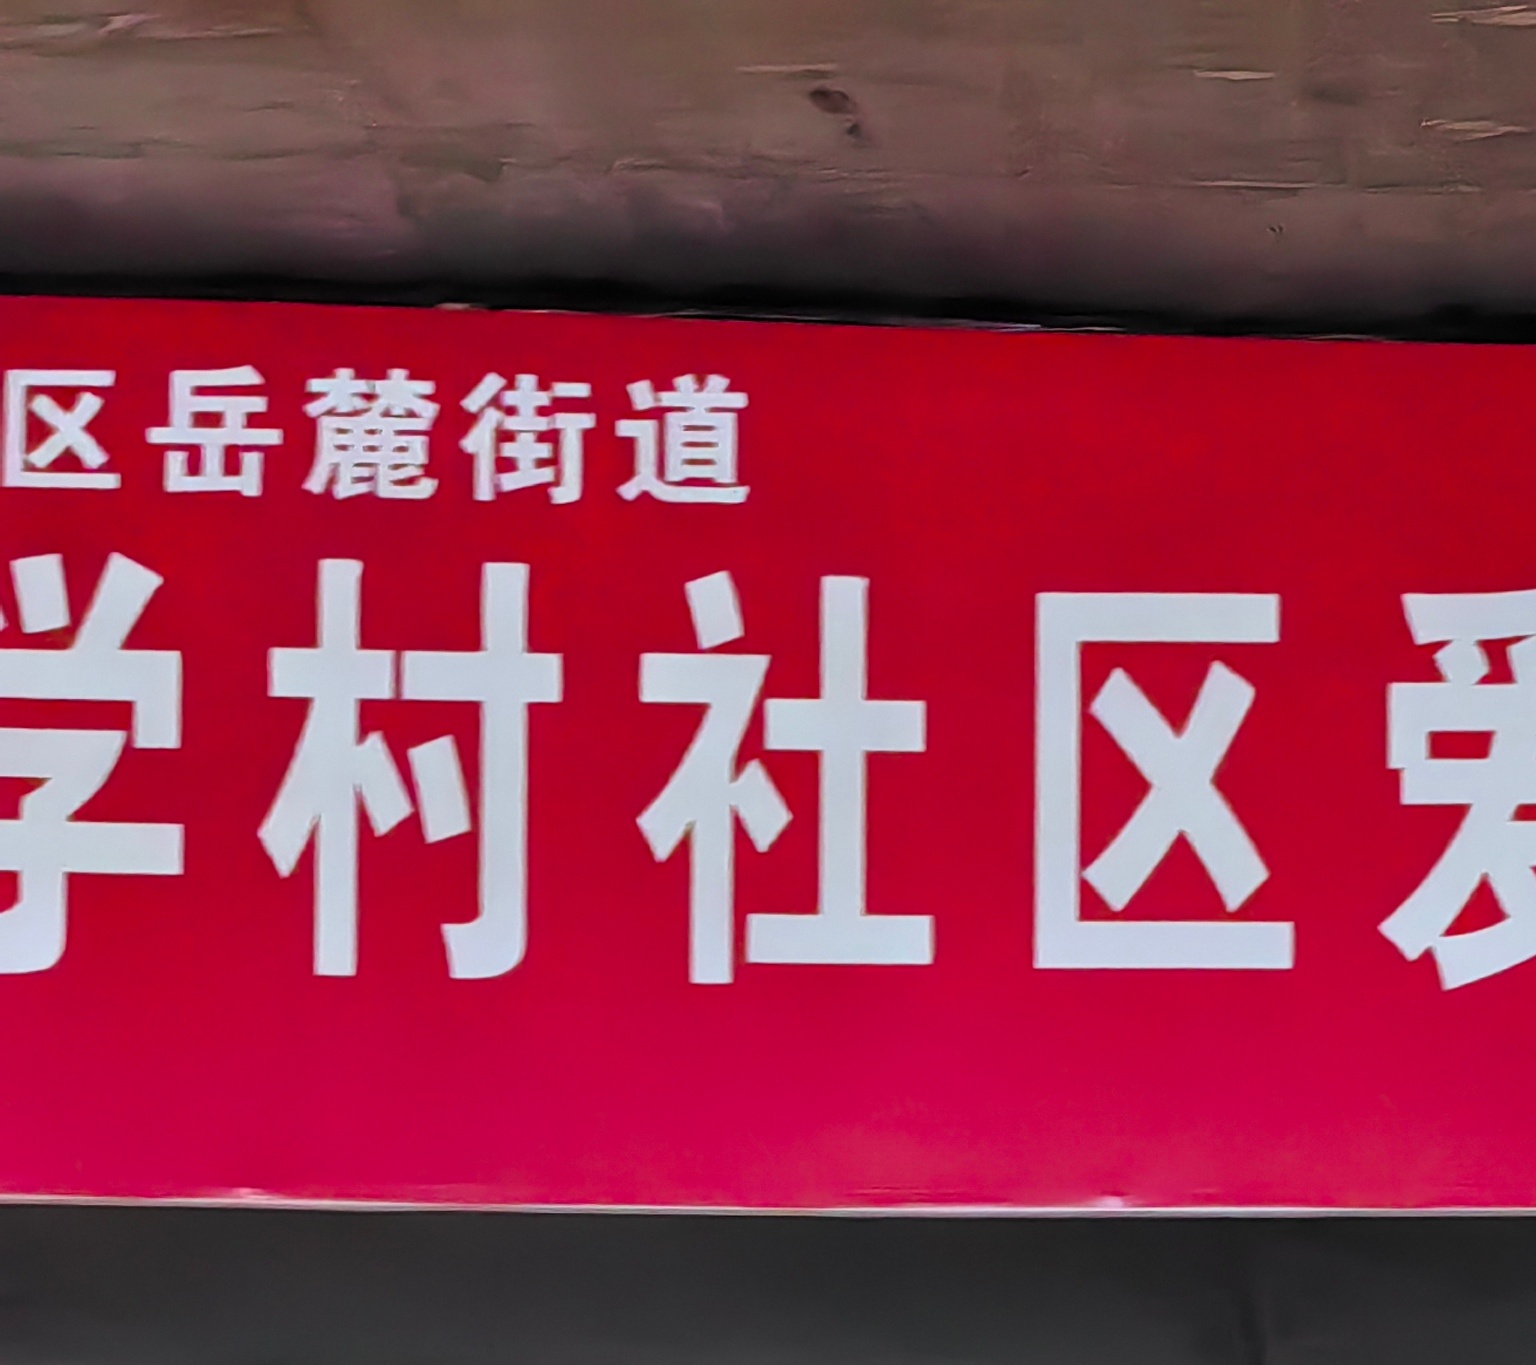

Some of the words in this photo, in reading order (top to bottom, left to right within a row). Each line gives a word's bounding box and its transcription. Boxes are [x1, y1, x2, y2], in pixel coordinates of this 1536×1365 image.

[3, 365, 749, 503] 区岳麓街道
